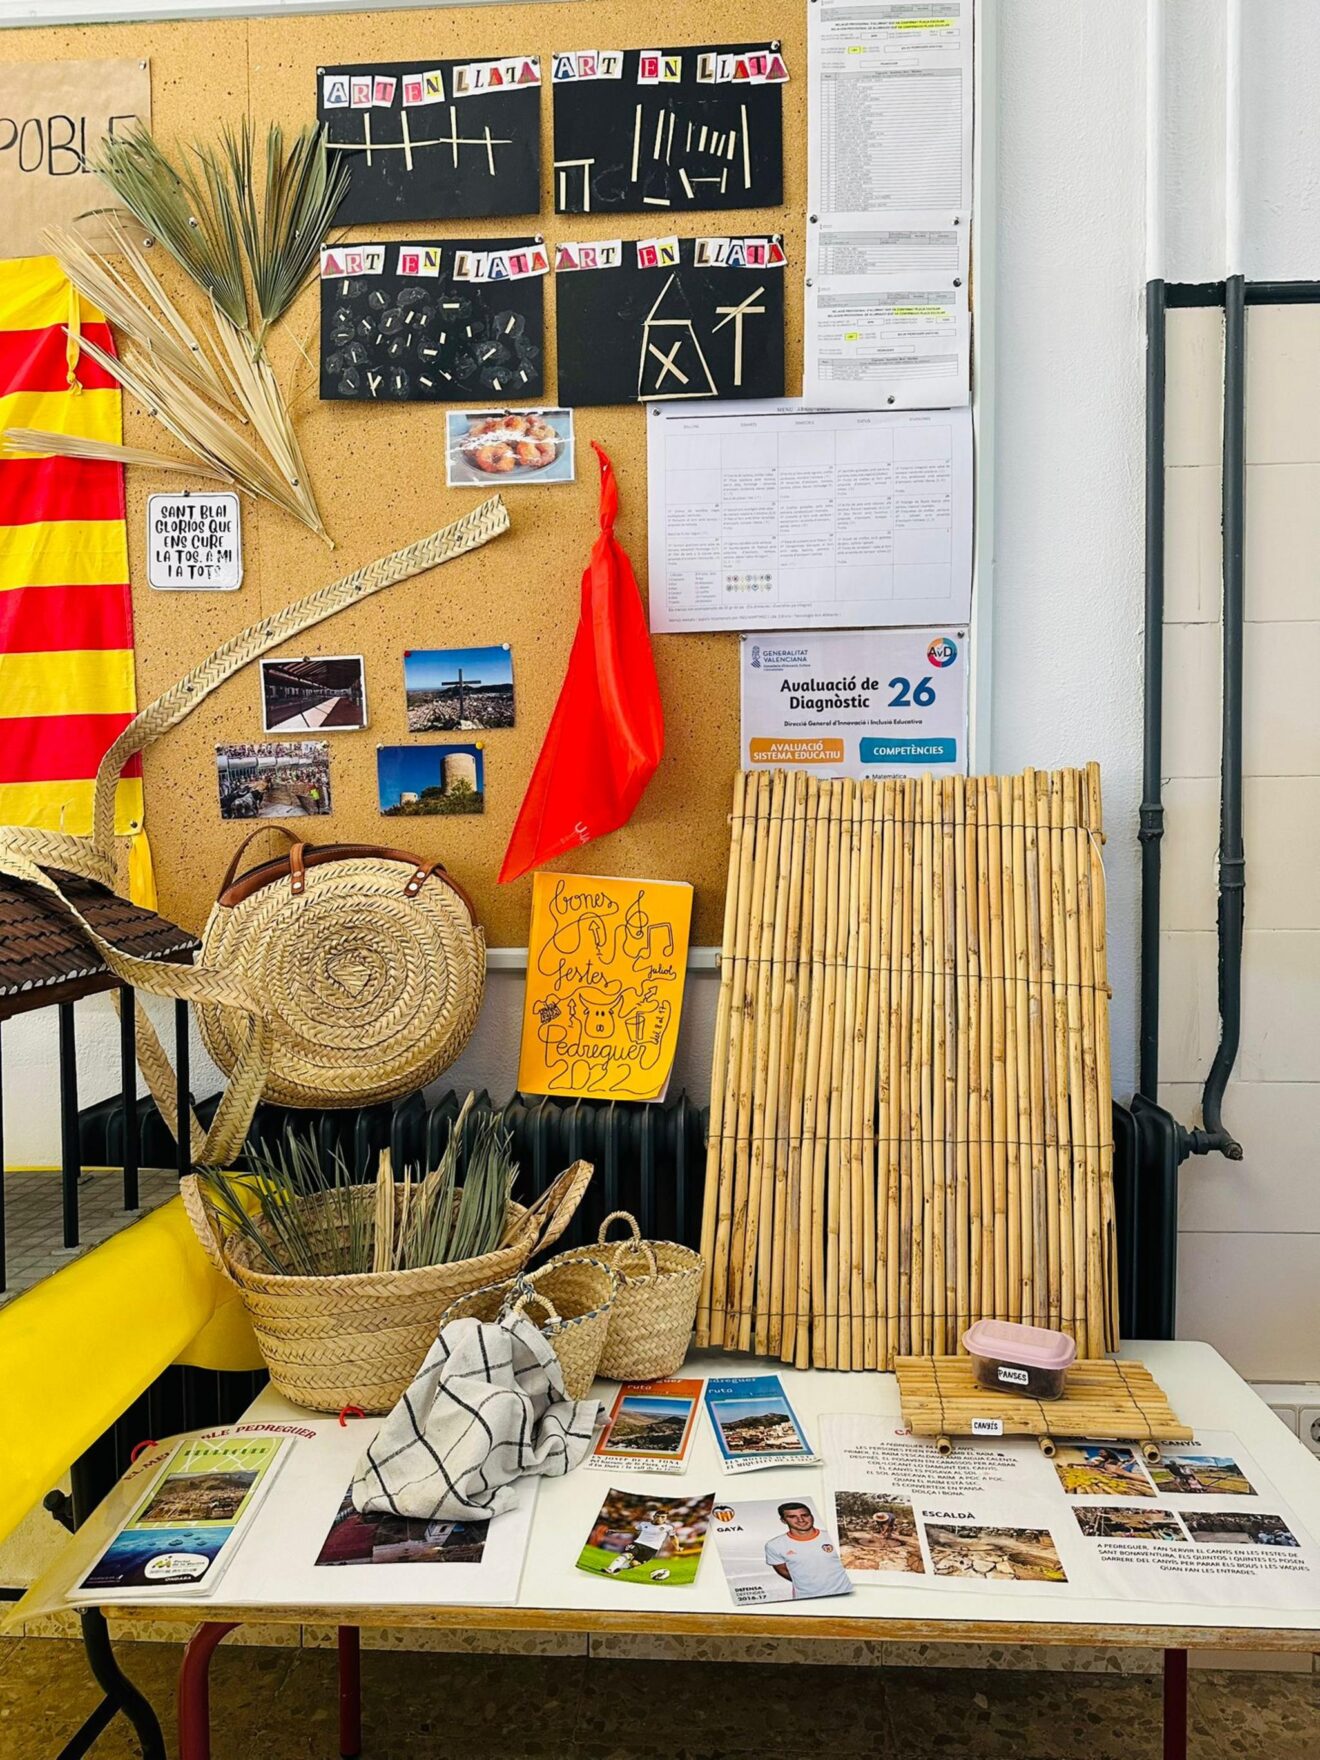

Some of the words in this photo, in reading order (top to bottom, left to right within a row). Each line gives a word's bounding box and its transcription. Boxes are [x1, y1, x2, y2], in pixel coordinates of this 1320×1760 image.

[554, 54, 618, 80] ART
[641, 55, 680, 79] EN
[698, 52, 788, 80] LLATA
[327, 81, 394, 104] ART
[405, 76, 440, 103] EN
[456, 61, 539, 92] LLATA
[556, 246, 616, 267] ART
[639, 244, 677, 265] EN
[697, 239, 785, 264] LLATA
[322, 251, 381, 275] ART
[402, 250, 440, 274] EN
[456, 251, 546, 277] LLATA
[161, 505, 196, 520] SANT
[200, 505, 227, 520] BLAI
[209, 519, 232, 533] QUE
[164, 535, 187, 549] ENS
[191, 534, 224, 550] CURE
[156, 550, 171, 562] LA
[176, 566, 183, 577] A
[762, 649, 808, 657] GENERALITAT
[780, 675, 857, 692] Avaluació
[861, 676, 880, 691] de
[887, 676, 937, 707] 26
[789, 694, 870, 712] Diagnòstic
[753, 751, 793, 761] SISTEMA
[795, 750, 841, 760] EDUCATIU
[873, 743, 944, 756] COMPETÈNCIES
[770, 740, 823, 752] AVALUACIÓ
[548, 1058, 655, 1094] 2022
[998, 1369, 1027, 1382] PANSES
[235, 1424, 317, 1440] PEDREGUER
[974, 1421, 999, 1430] CANYÍS
[922, 1509, 976, 1520] ESCALDÀ
